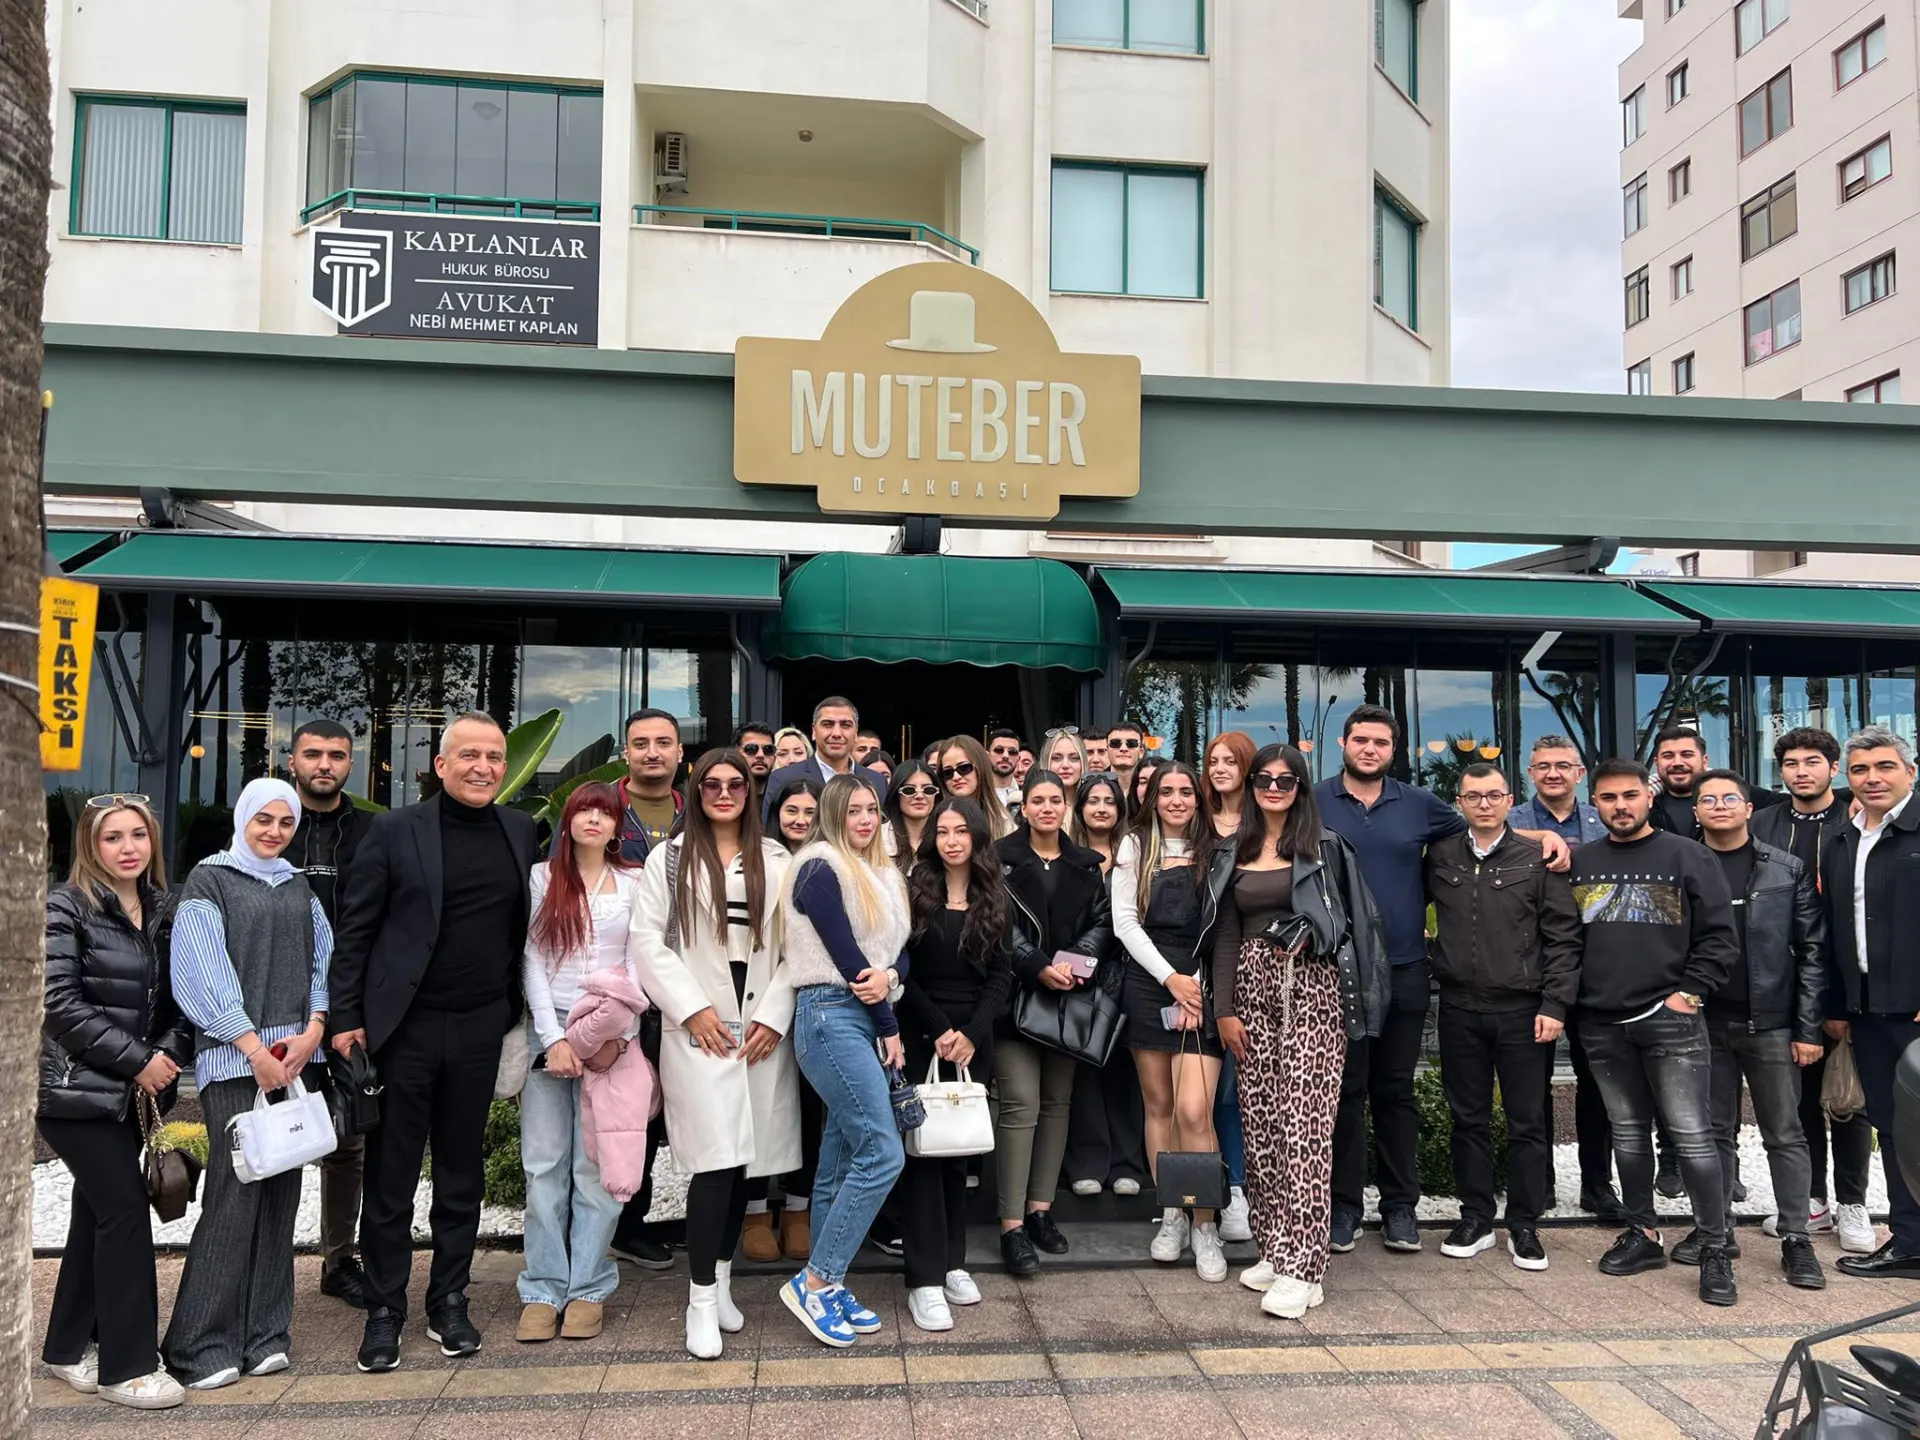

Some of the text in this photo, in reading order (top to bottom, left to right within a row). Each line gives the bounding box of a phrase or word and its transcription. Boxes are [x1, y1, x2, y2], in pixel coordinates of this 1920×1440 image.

[403, 230, 587, 259] KAPLANLAR
[441, 262, 550, 279] HUKUK BÜROSU
[435, 291, 554, 315] AVUKAT
[410, 312, 578, 335] NEBİ MEHMET KAPLAN
[790, 369, 1087, 467] MUTEBER
[853, 476, 1027, 500] OCAKBAŞI
[1590, 874, 1675, 882] YOURSELF
[289, 1122, 304, 1134] mini
